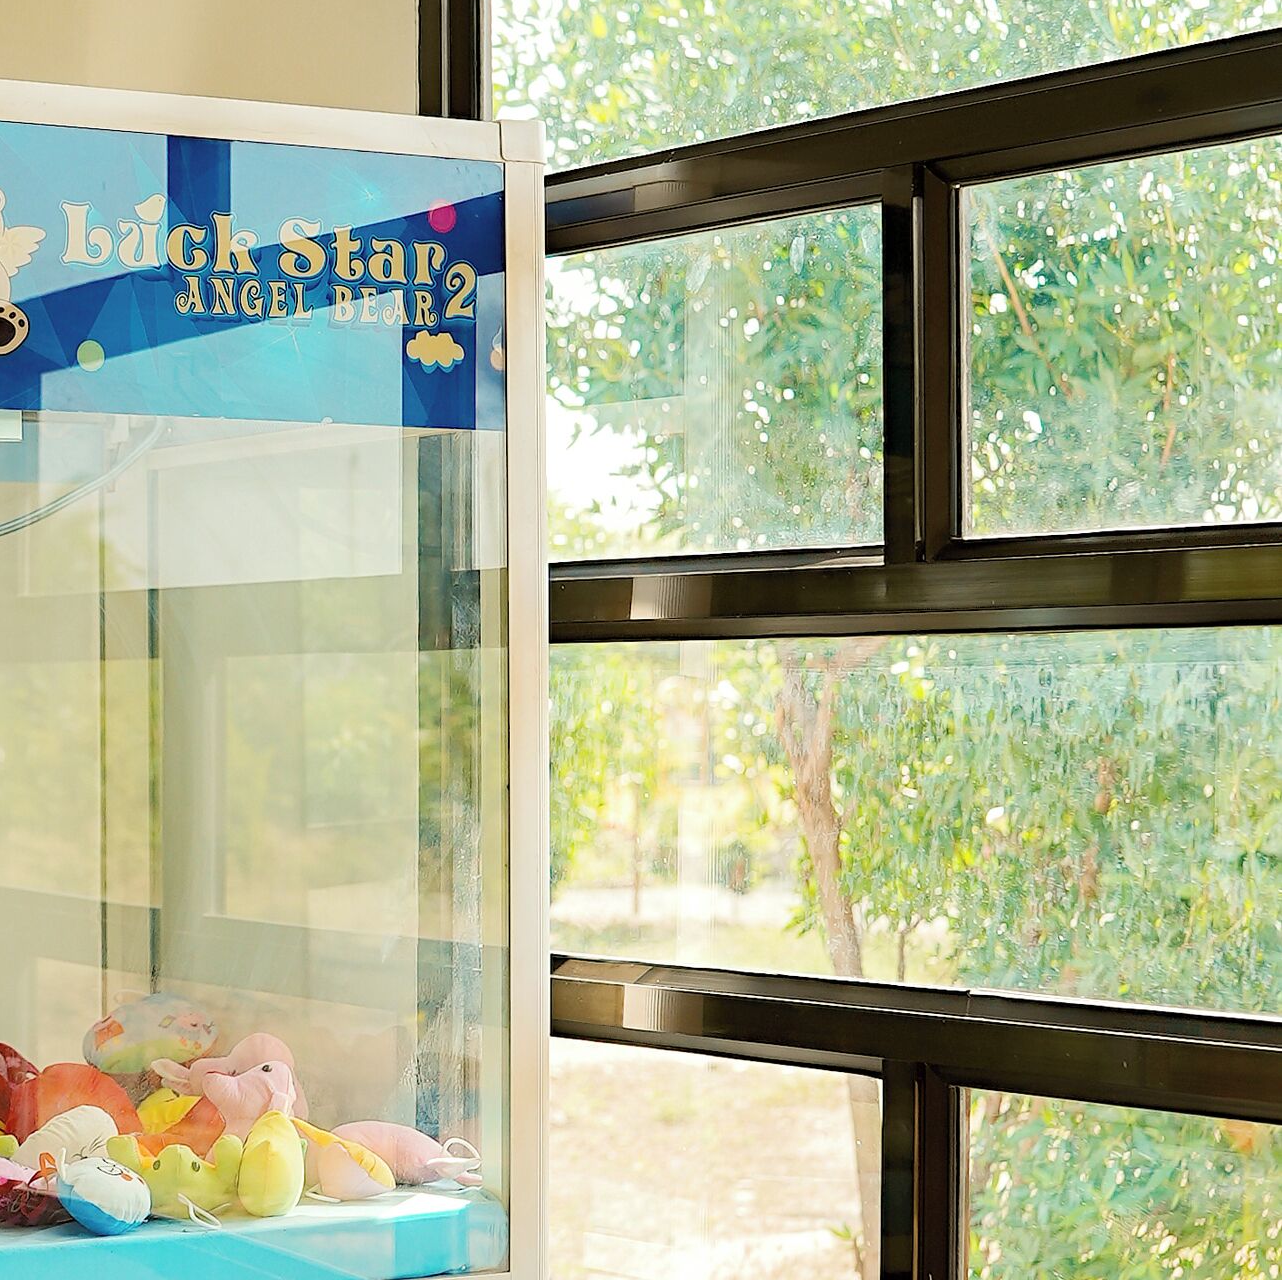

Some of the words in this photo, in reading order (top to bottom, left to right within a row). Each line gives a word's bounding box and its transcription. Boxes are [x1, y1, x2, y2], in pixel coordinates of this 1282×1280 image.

[60, 201, 260, 275] Luck
[278, 217, 447, 287] Star
[175, 276, 315, 319] ANGEL
[332, 283, 439, 327] BEAR
